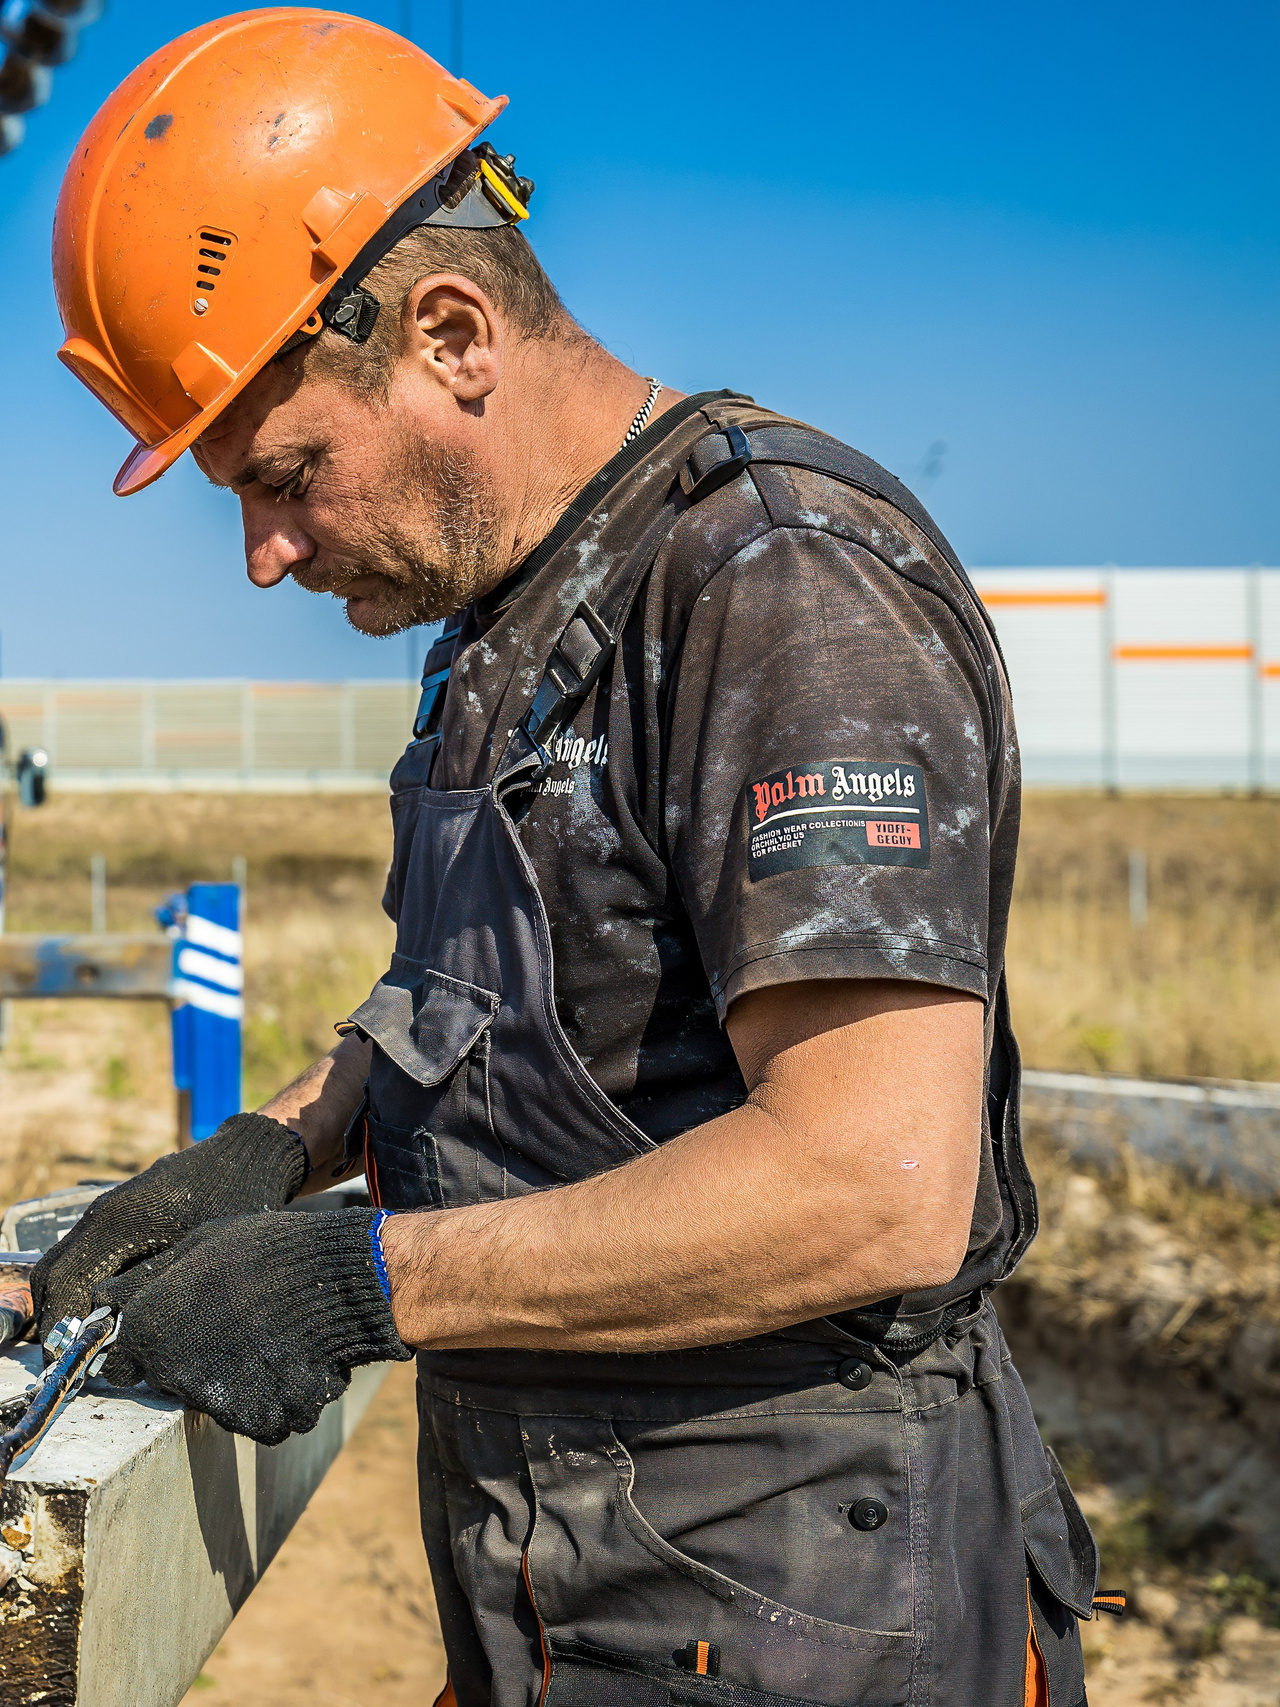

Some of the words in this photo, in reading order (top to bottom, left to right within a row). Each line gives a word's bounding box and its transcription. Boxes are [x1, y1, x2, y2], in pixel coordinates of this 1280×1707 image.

[753, 771, 827, 822] Palm
[831, 766, 916, 803] Angels
[783, 823, 807, 835] WEAR
[752, 848, 767, 859] FOR
